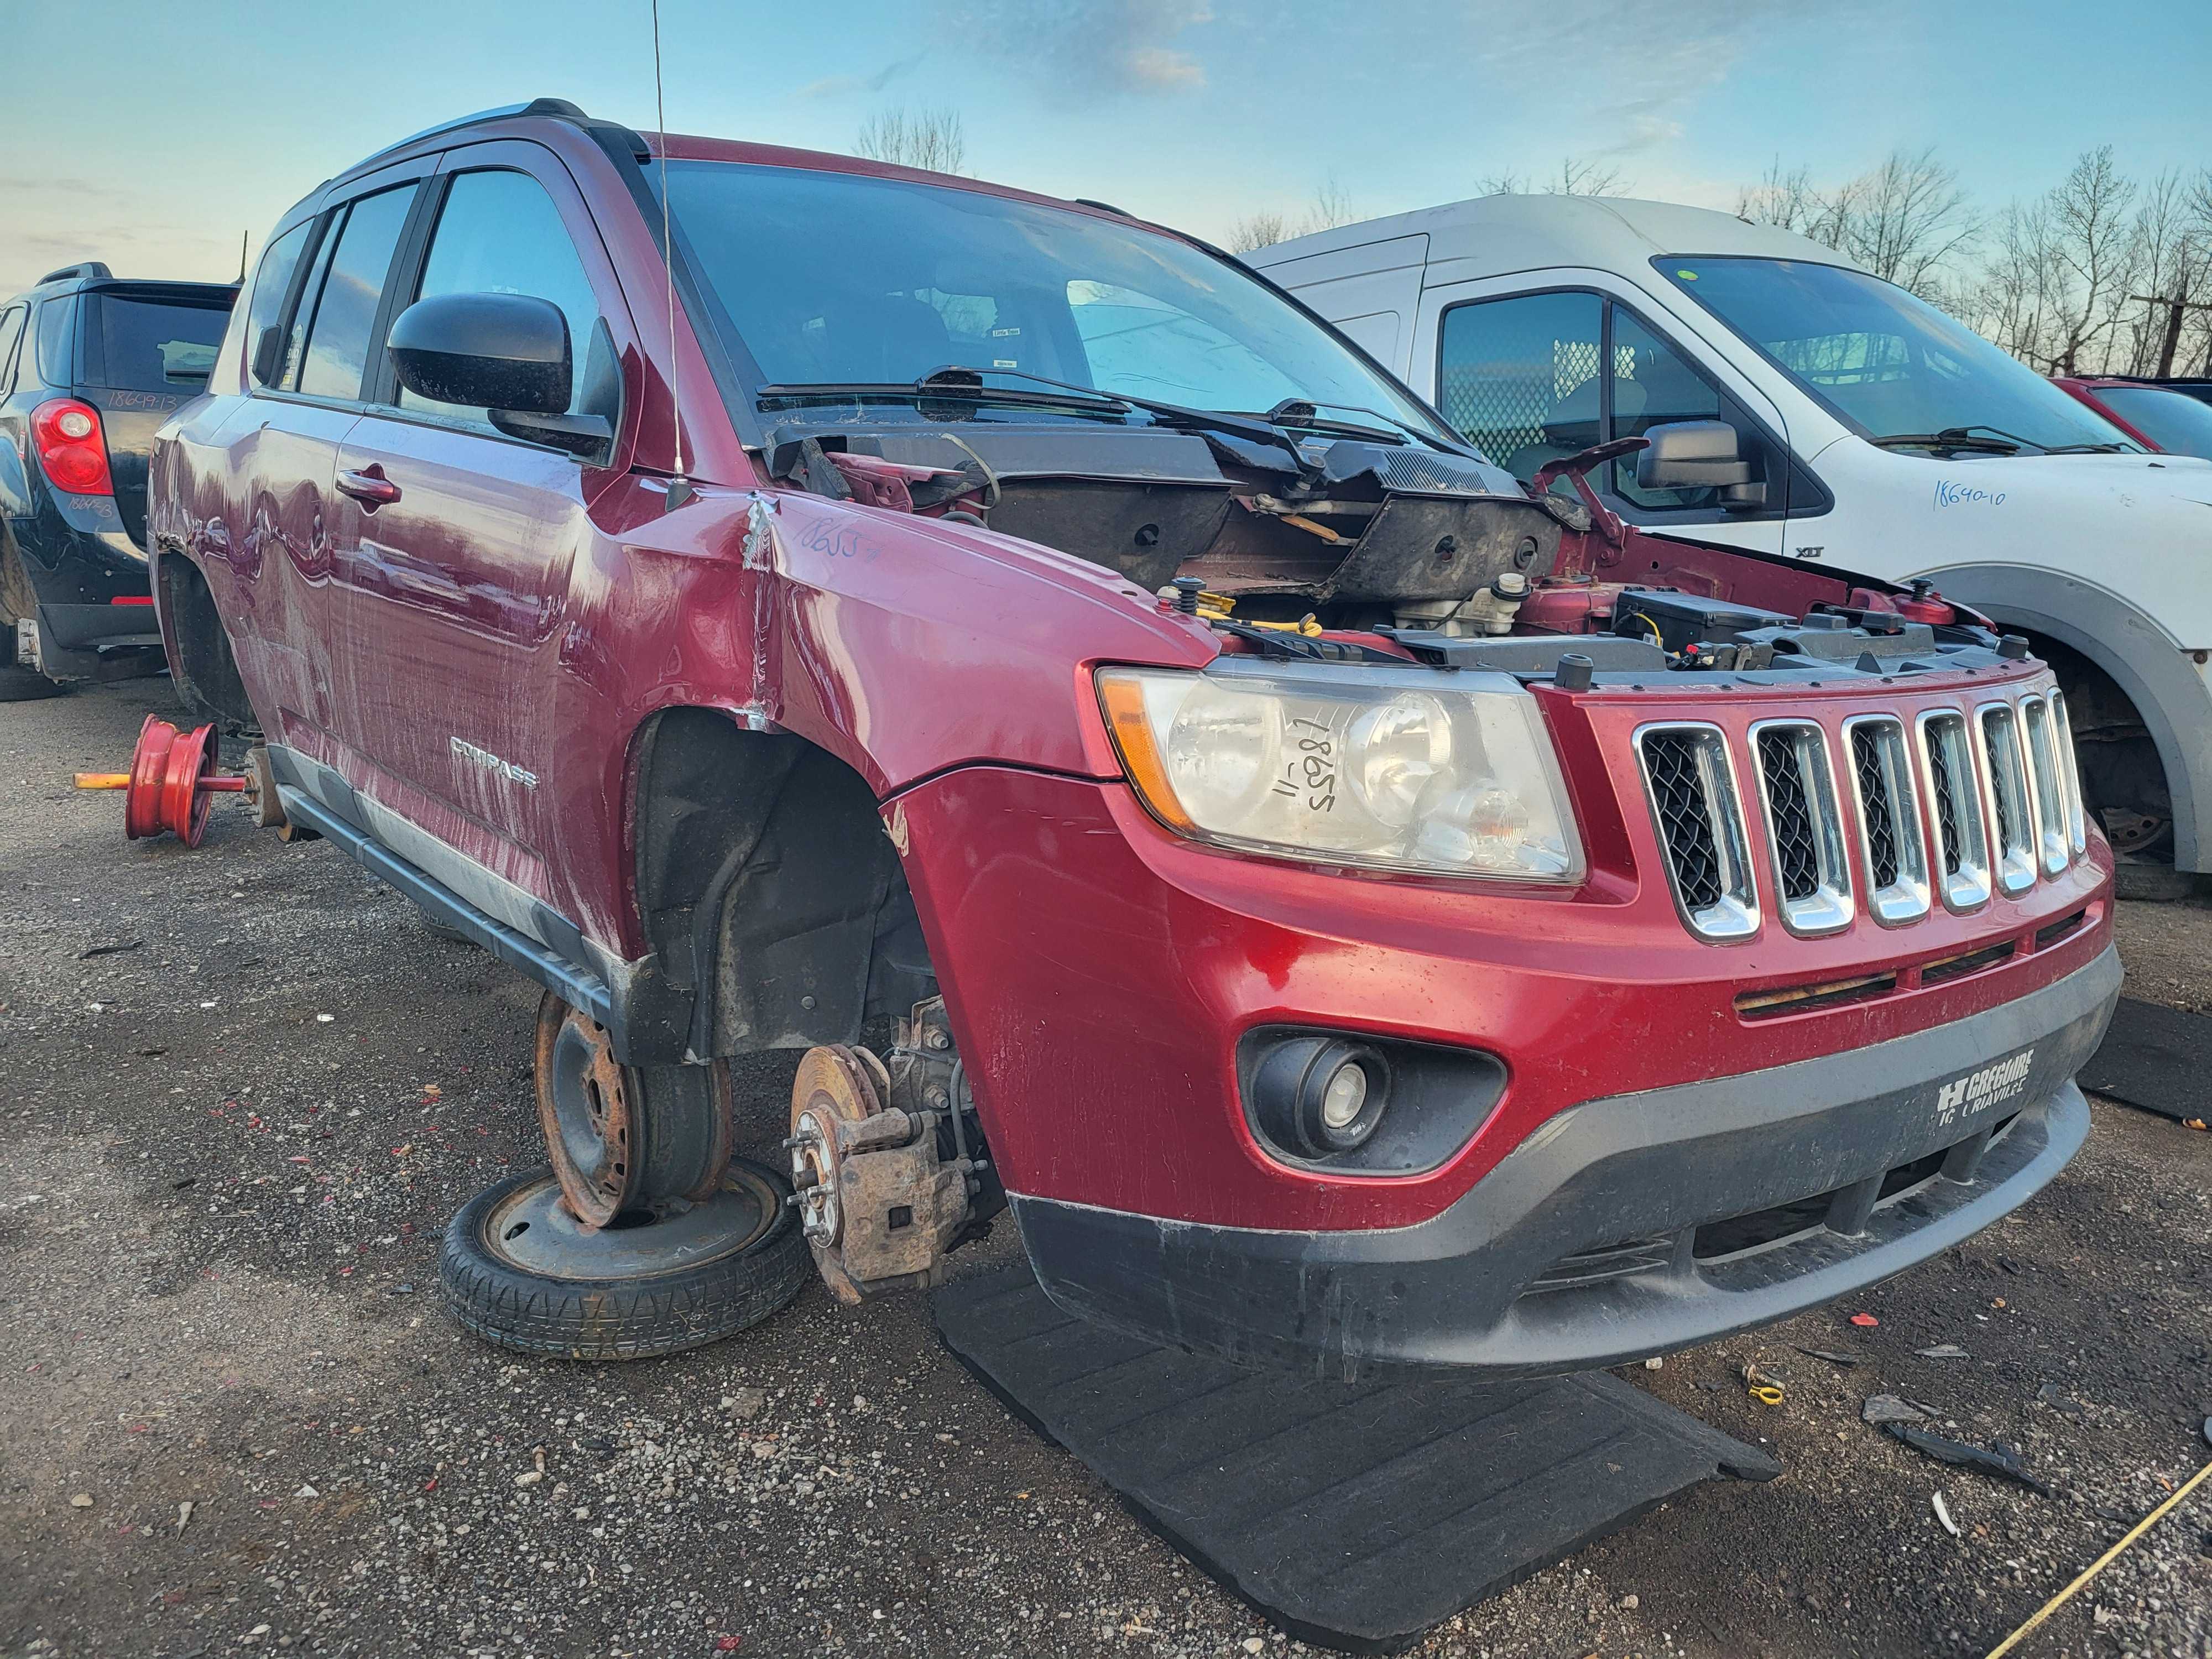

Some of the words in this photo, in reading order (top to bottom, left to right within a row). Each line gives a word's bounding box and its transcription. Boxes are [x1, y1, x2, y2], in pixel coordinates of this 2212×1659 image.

[108, 390, 177, 410] 18649-13
[1933, 480, 2005, 512] 18640-10
[1796, 546, 1824, 558] XLT
[451, 736, 538, 791] COMPASS
